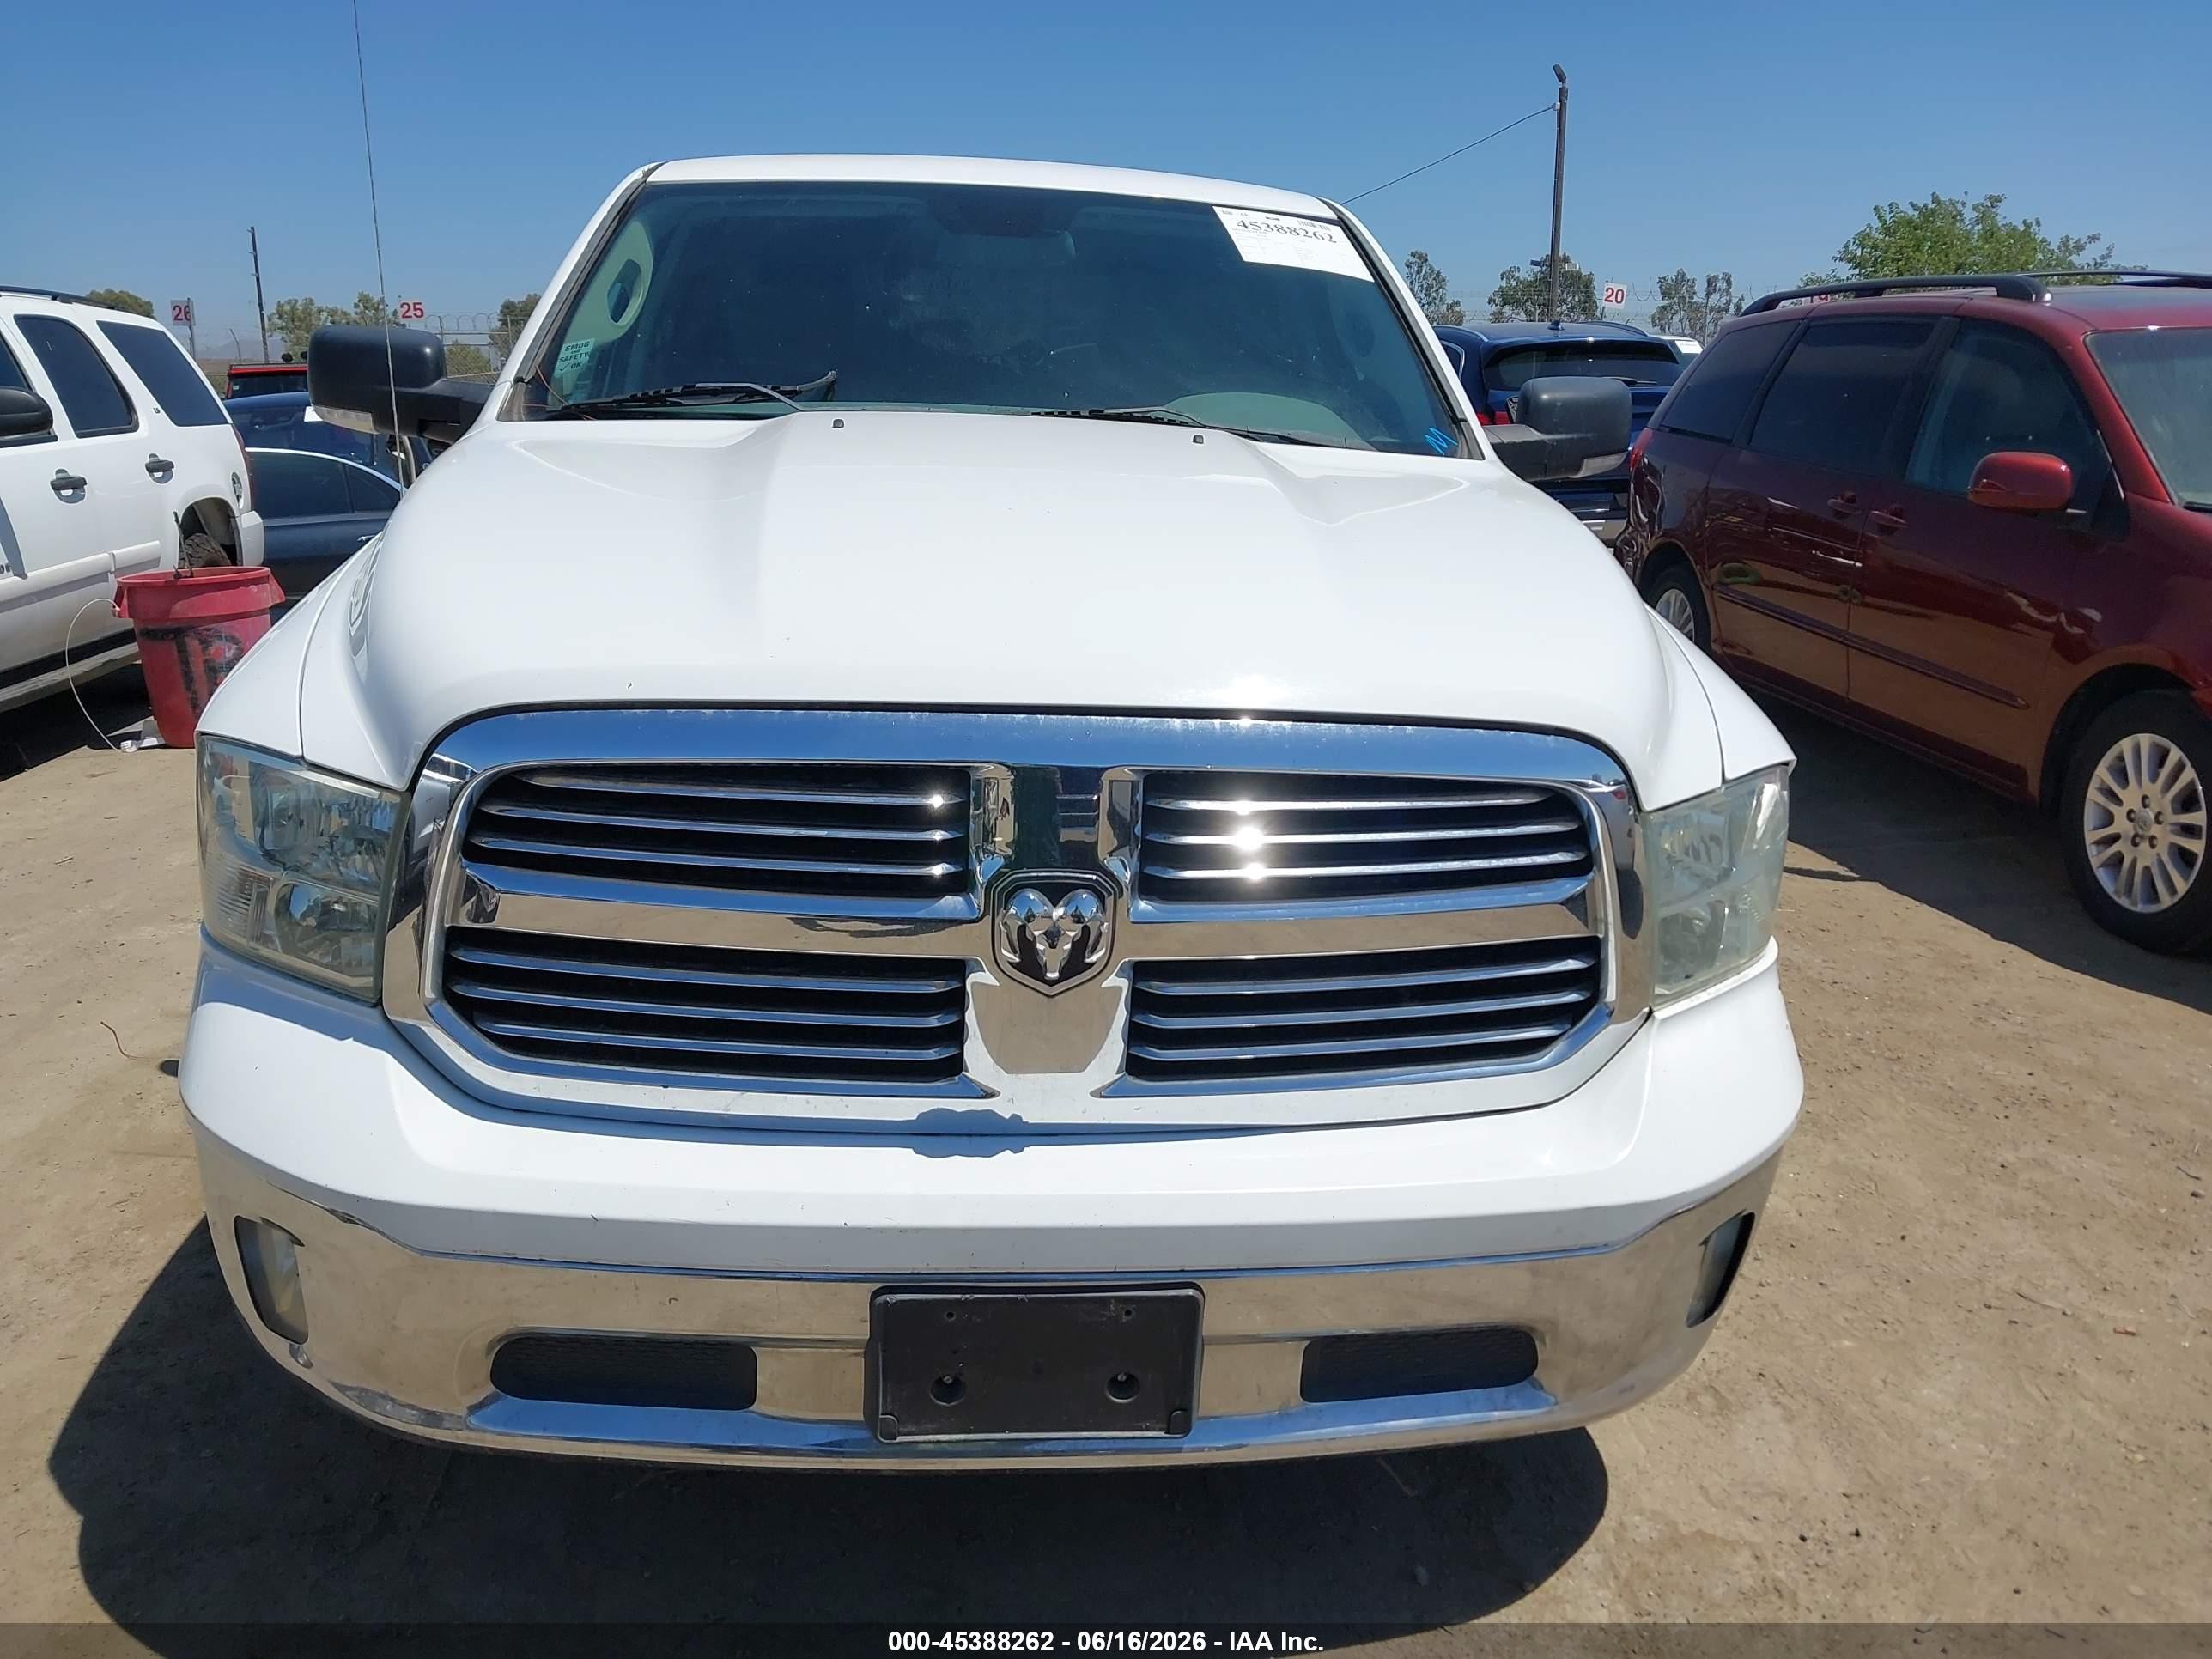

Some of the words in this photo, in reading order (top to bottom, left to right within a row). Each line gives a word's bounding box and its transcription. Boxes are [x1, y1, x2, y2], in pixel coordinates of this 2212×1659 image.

[1237, 220, 1337, 244] 45388262
[1604, 287, 1625, 304] 20
[400, 301, 424, 319] 25
[564, 341, 591, 352] SMOG
[558, 351, 591, 363] SAFETY
